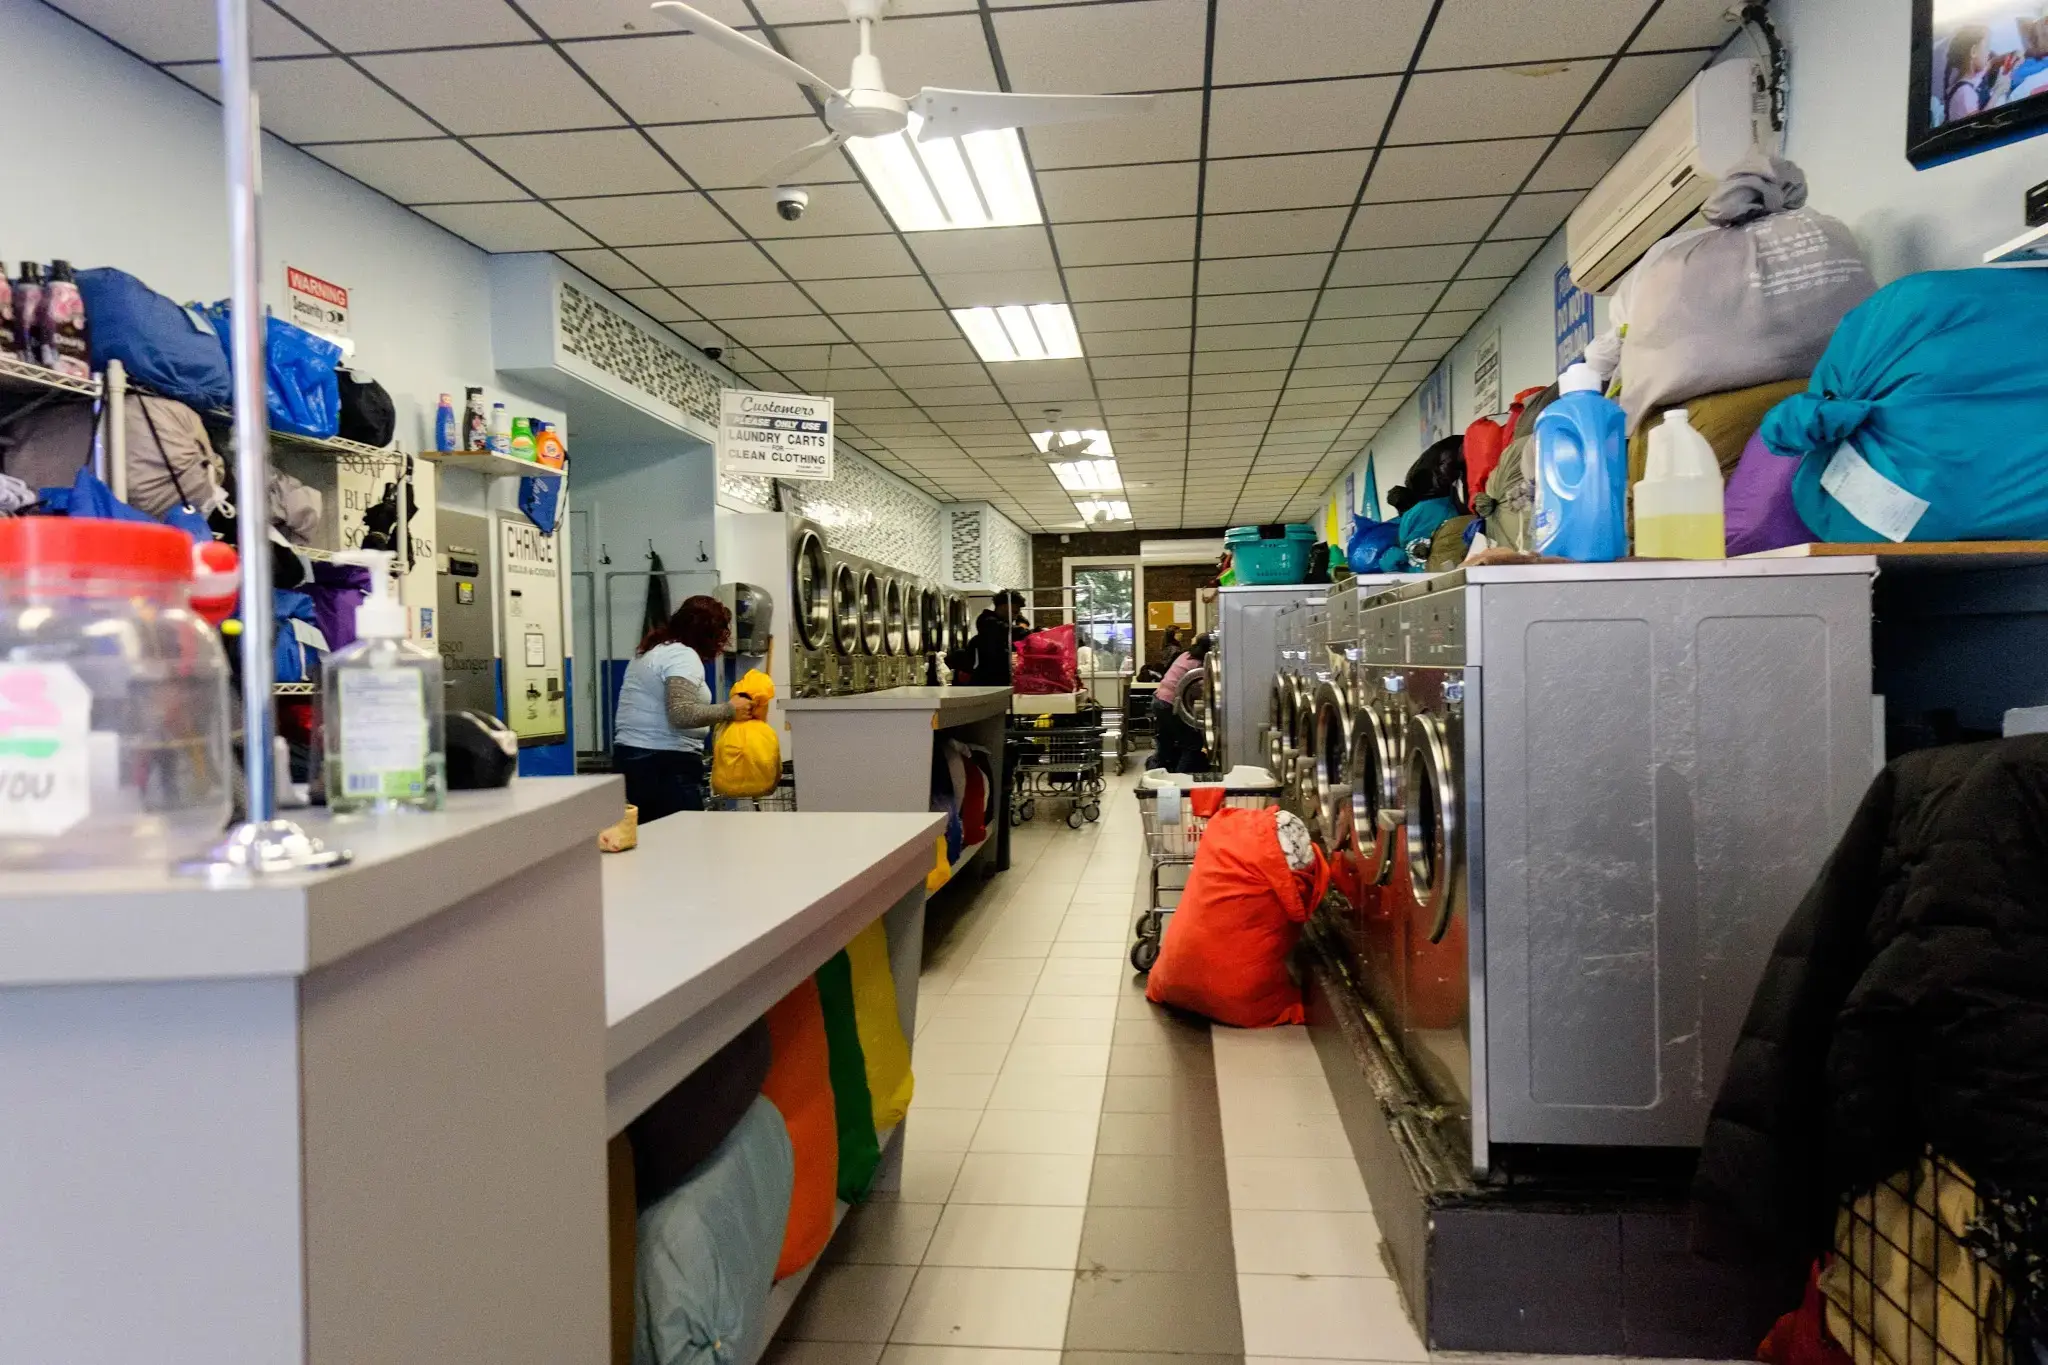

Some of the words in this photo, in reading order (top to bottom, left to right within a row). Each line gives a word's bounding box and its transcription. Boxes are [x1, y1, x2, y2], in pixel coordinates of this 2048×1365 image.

[290, 270, 346, 306] WARNING
[740, 396, 814, 416] Customers
[733, 415, 770, 427] PLEASE
[774, 419, 798, 430] ONLY
[801, 421, 821, 431] USE
[728, 428, 781, 443] LAUNDRY
[787, 434, 825, 447] CARTS
[343, 453, 385, 478] SOAP
[728, 448, 766, 460] CLEAN
[771, 452, 826, 465] CLOTHING
[507, 526, 553, 563] CHANGE
[444, 653, 488, 675] Changer
